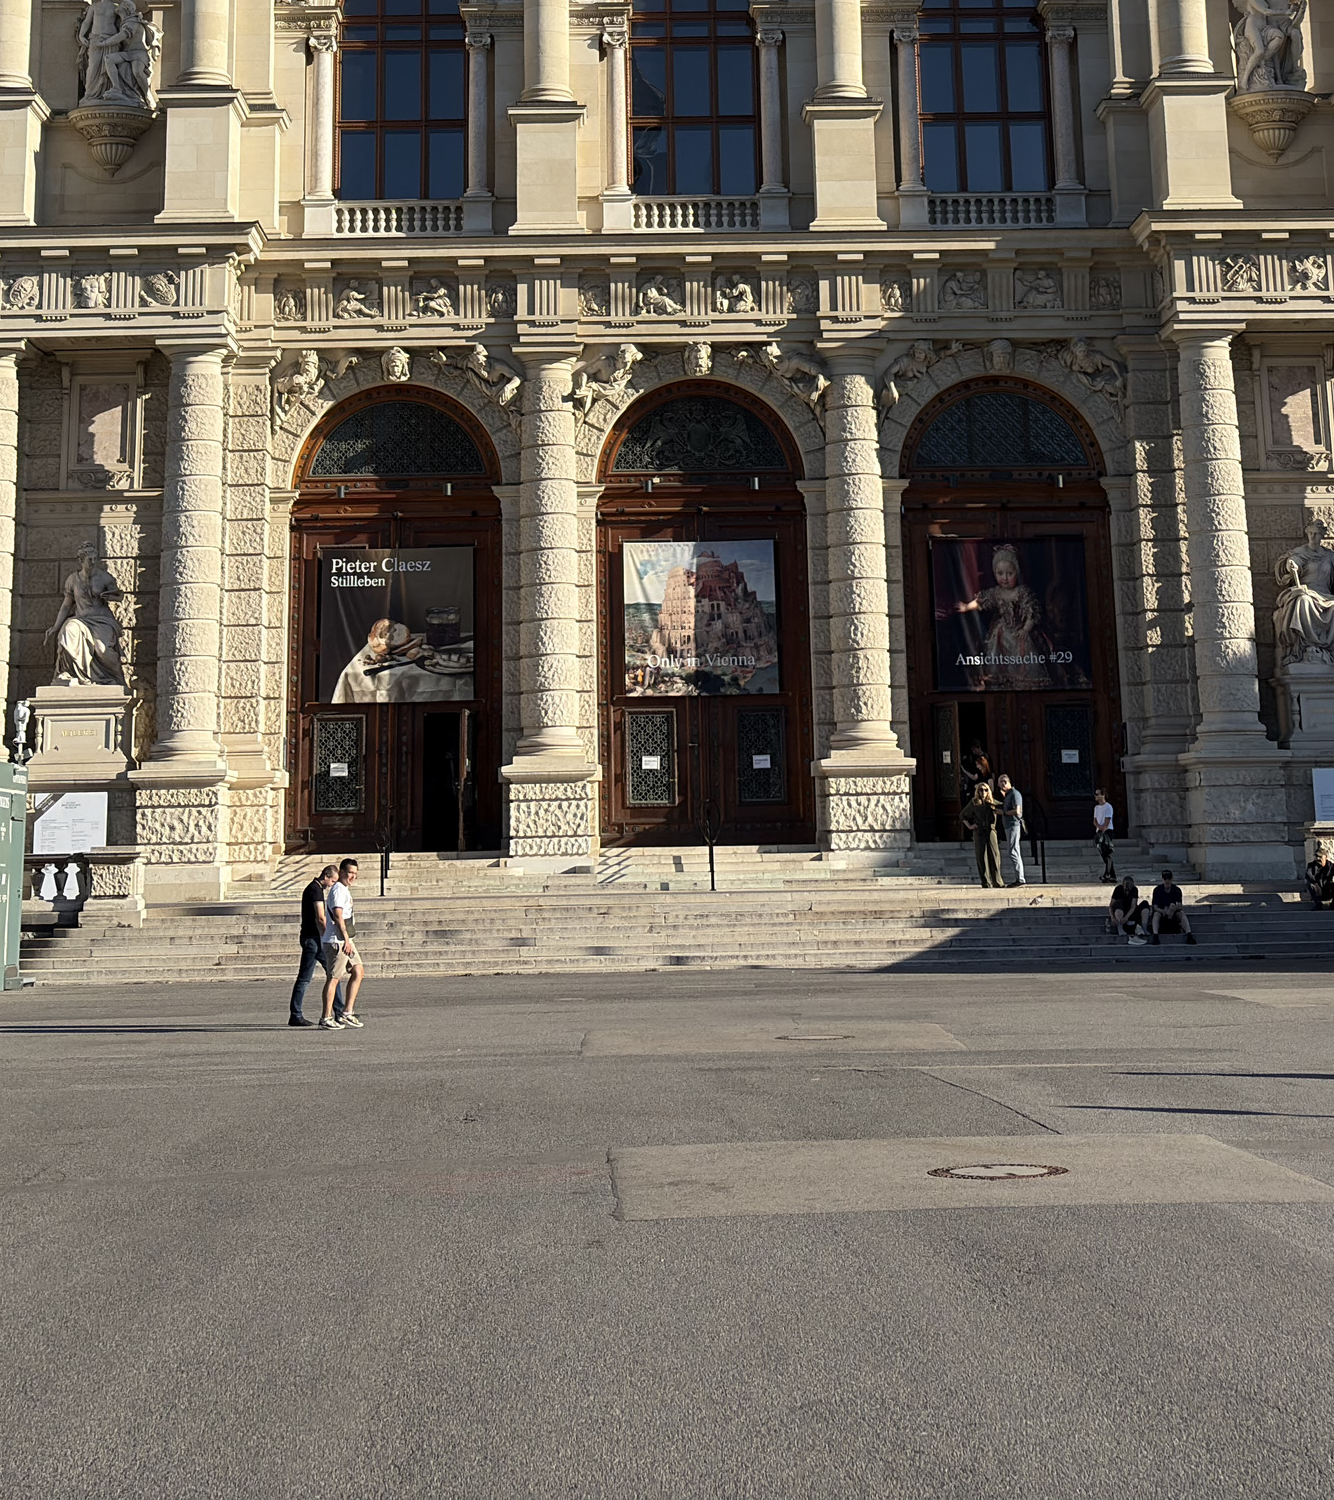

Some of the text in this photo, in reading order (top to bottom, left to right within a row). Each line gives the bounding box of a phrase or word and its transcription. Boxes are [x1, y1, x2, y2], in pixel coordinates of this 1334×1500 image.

[331, 557, 431, 573] Pieter Claesz
[330, 575, 386, 587] Stillleben
[647, 652, 756, 670] Only in Vienna
[955, 650, 1073, 666] Ansichtssache #29
